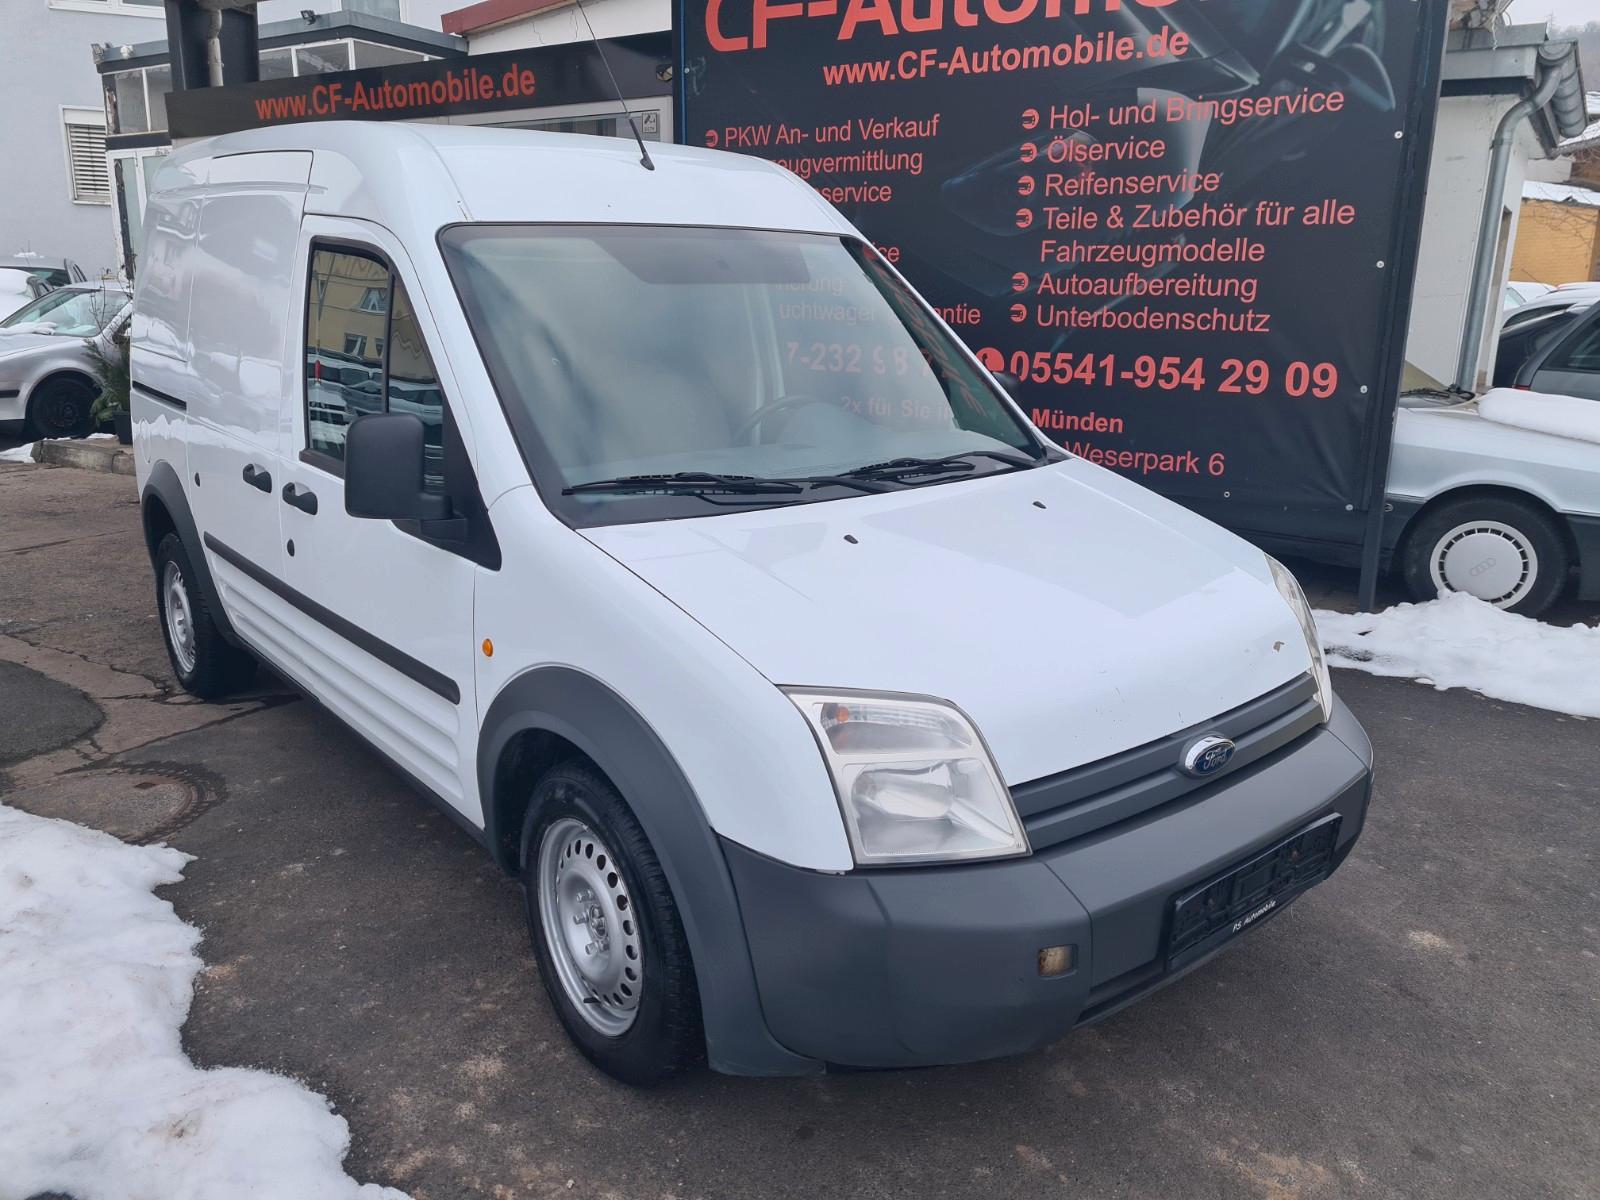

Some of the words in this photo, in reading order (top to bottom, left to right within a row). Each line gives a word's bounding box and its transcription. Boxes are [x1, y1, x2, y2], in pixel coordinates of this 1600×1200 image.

[822, 26, 1190, 88] www.CF-Automobile.de
[255, 64, 536, 121] www.CF-Automobile.de
[1050, 105, 1101, 129] Hol-
[1108, 101, 1157, 127] und
[1166, 91, 1345, 127] Bringservice
[725, 124, 772, 148] PKW
[776, 123, 809, 145] An-
[815, 119, 852, 144] und
[858, 113, 940, 142] Verkauf
[773, 149, 924, 181] eugvermittlung
[1046, 136, 1167, 165] Ölservice
[815, 181, 893, 204] service
[1044, 169, 1222, 198] Reifenservice
[1043, 205, 1098, 231] Teile
[1105, 204, 1125, 230] &
[1131, 203, 1247, 230] Zubehör
[1255, 201, 1295, 227] für
[1302, 200, 1356, 226] alle
[1039, 238, 1266, 269] Fahrzeugmodelle
[1036, 271, 1259, 304] Autoaufbereitung
[1036, 304, 1271, 333] Unterbodenschutz
[1008, 349, 1206, 393] 05541-954
[1218, 358, 1271, 397] 29
[1284, 360, 1340, 400] 09
[1031, 408, 1125, 434] Münden
[1064, 441, 1200, 475] Weserpark
[1207, 451, 1226, 477] 6
[1203, 747, 1230, 770] Ford
